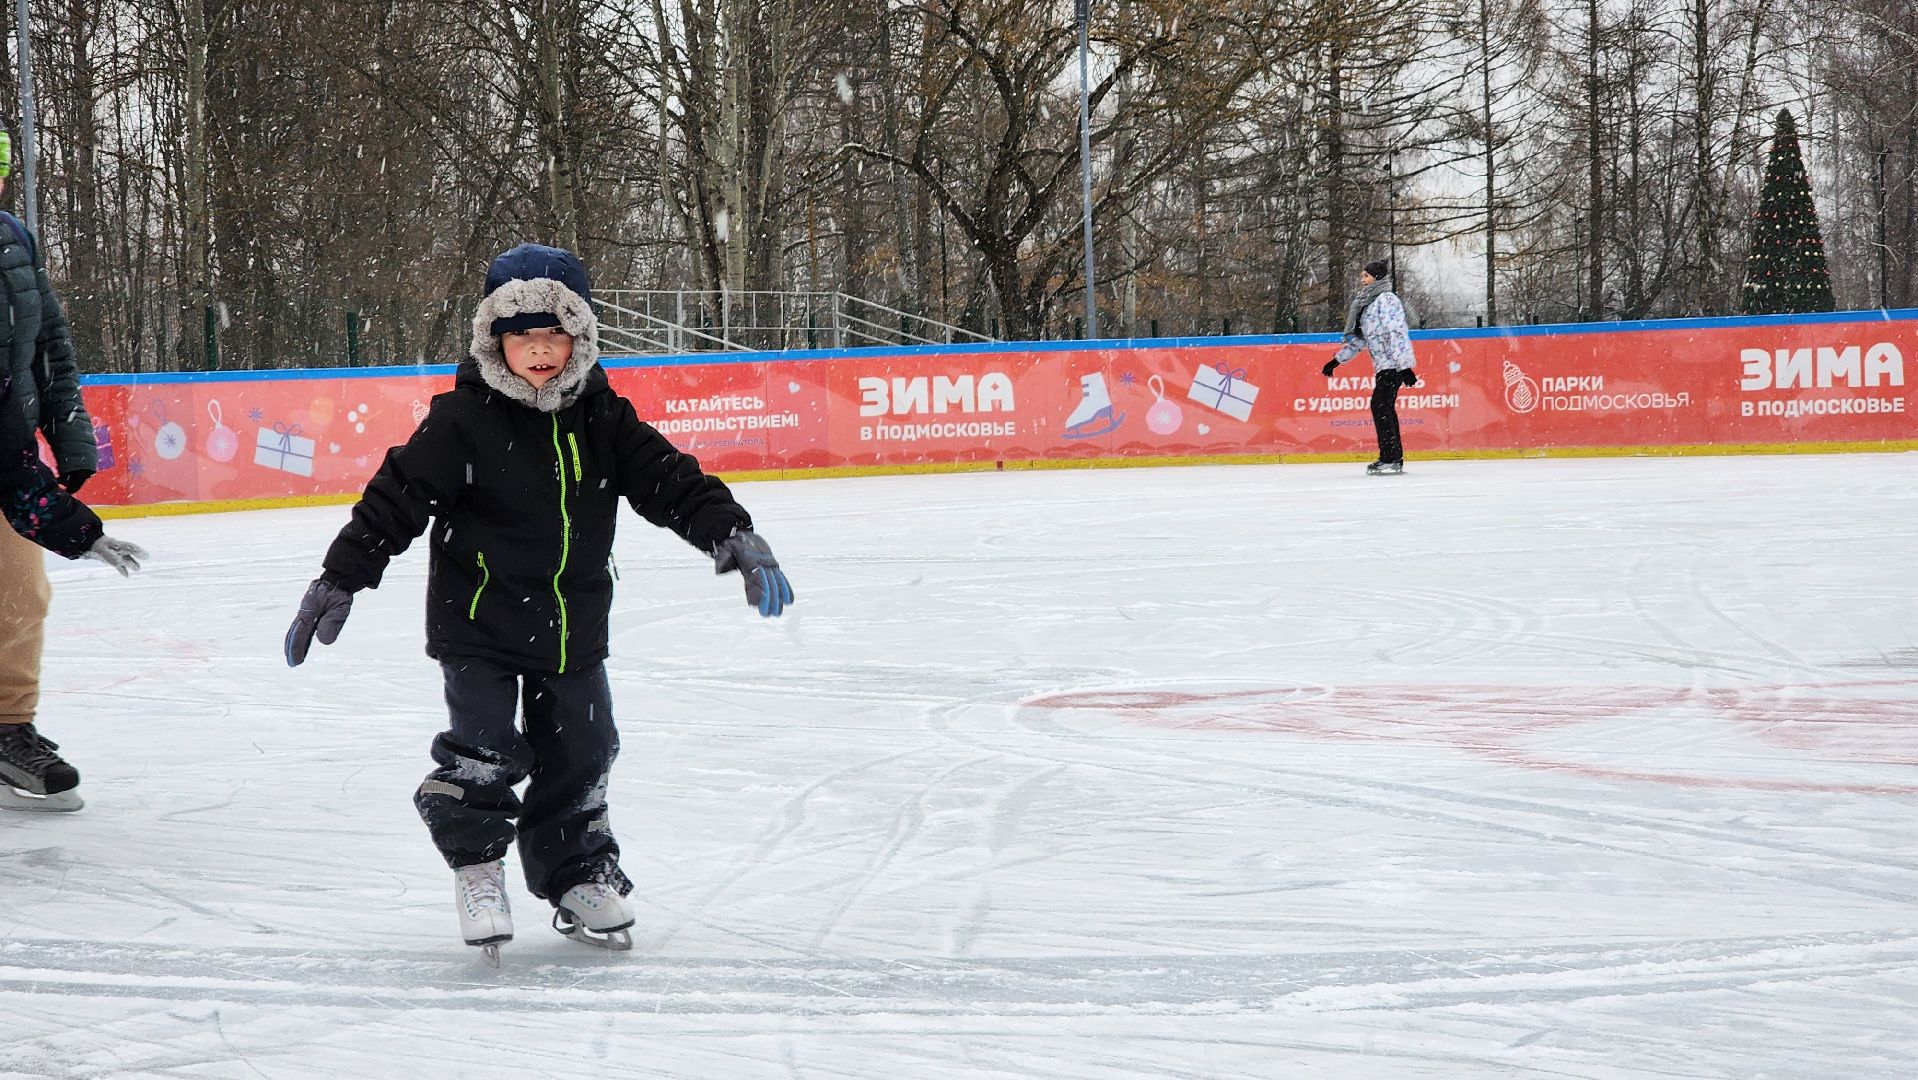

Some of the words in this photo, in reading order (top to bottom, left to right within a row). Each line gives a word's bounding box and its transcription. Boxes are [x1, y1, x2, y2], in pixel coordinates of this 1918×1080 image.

[1740, 342, 1905, 391] ЗИМА
[1327, 374, 1426, 391] КАТАЬ
[1542, 376, 1603, 392] ПАРКИ
[665, 395, 764, 413] КАТАЙТЕСЬ
[859, 372, 1016, 417] ЗИМА
[1294, 399, 1306, 412] С
[1308, 394, 1460, 413] УДОВОТВИЕМ!
[1542, 392, 1689, 411] ПОДМОСКОВЬЯ
[1741, 402, 1754, 417] В
[1757, 397, 1905, 418] ПОДМОСКОВЬЕ
[860, 426, 873, 441] В
[876, 421, 1016, 442] ПОДМОСКОВЬЕ
